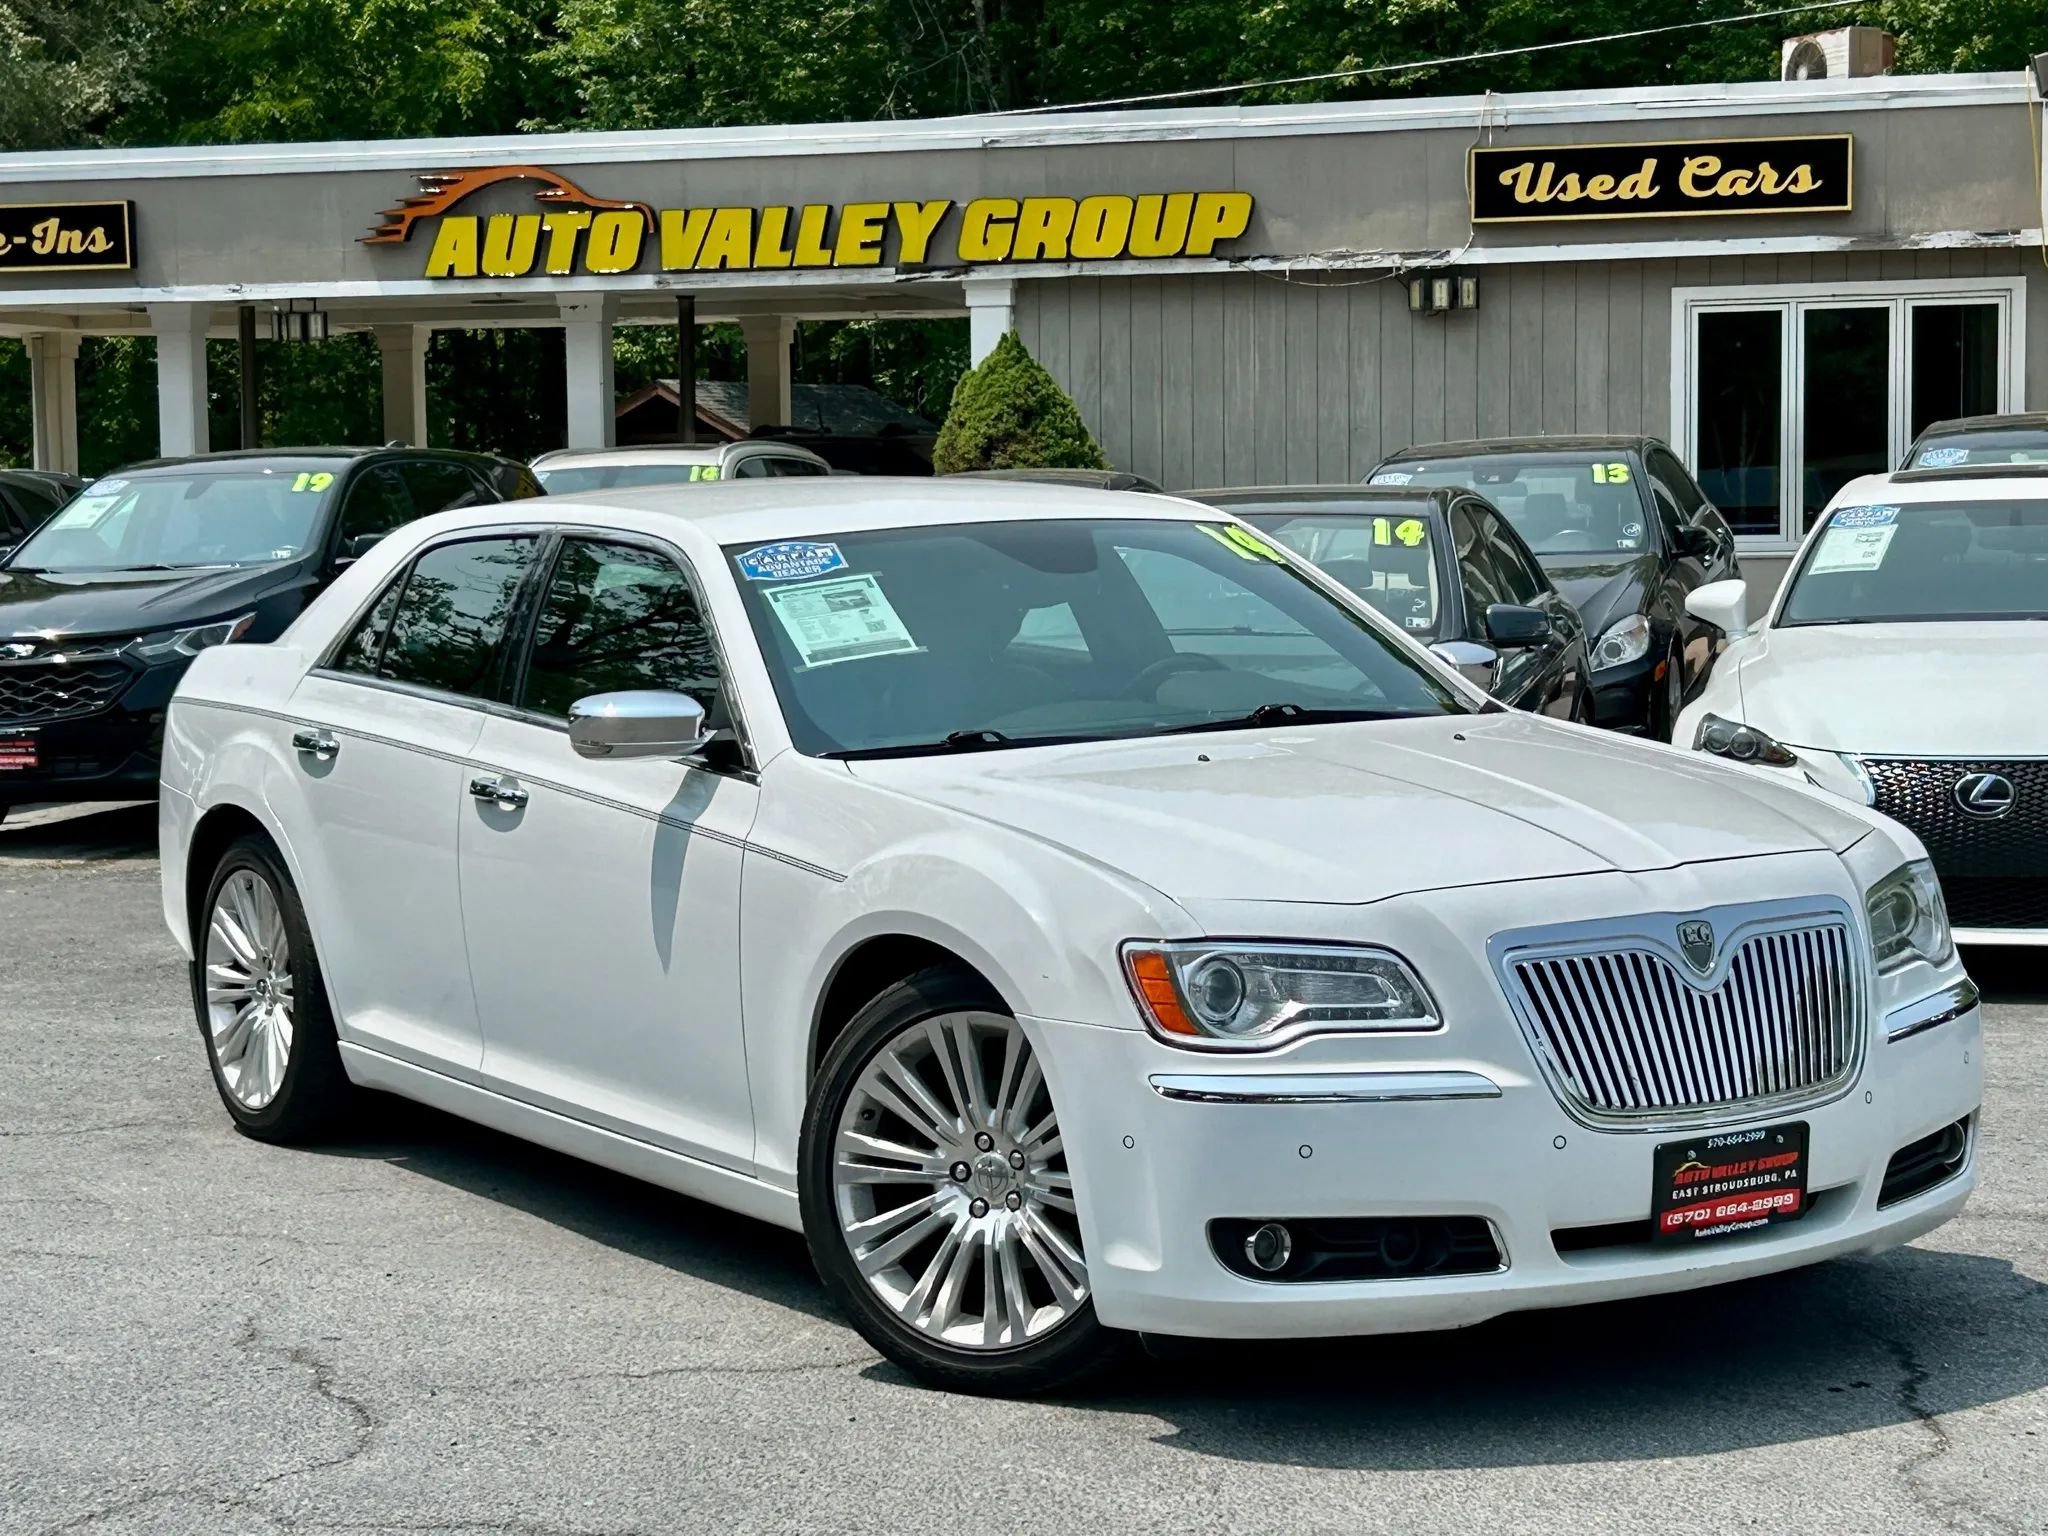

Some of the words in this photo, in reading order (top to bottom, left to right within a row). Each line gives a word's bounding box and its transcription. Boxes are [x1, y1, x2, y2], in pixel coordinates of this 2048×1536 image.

[1499, 158, 1660, 203] Used
[1679, 155, 1823, 197] Cars
[425, 210, 645, 278] AUTO
[660, 200, 951, 271] VALLEY
[958, 192, 1253, 262] GROUP
[291, 472, 334, 492] 19
[1591, 463, 1630, 484] 13
[1372, 518, 1425, 546] 14
[1672, 1187, 1699, 1200] EAST
[1784, 1169, 1797, 1180] PA
[1667, 1209, 1711, 1226] (570)
